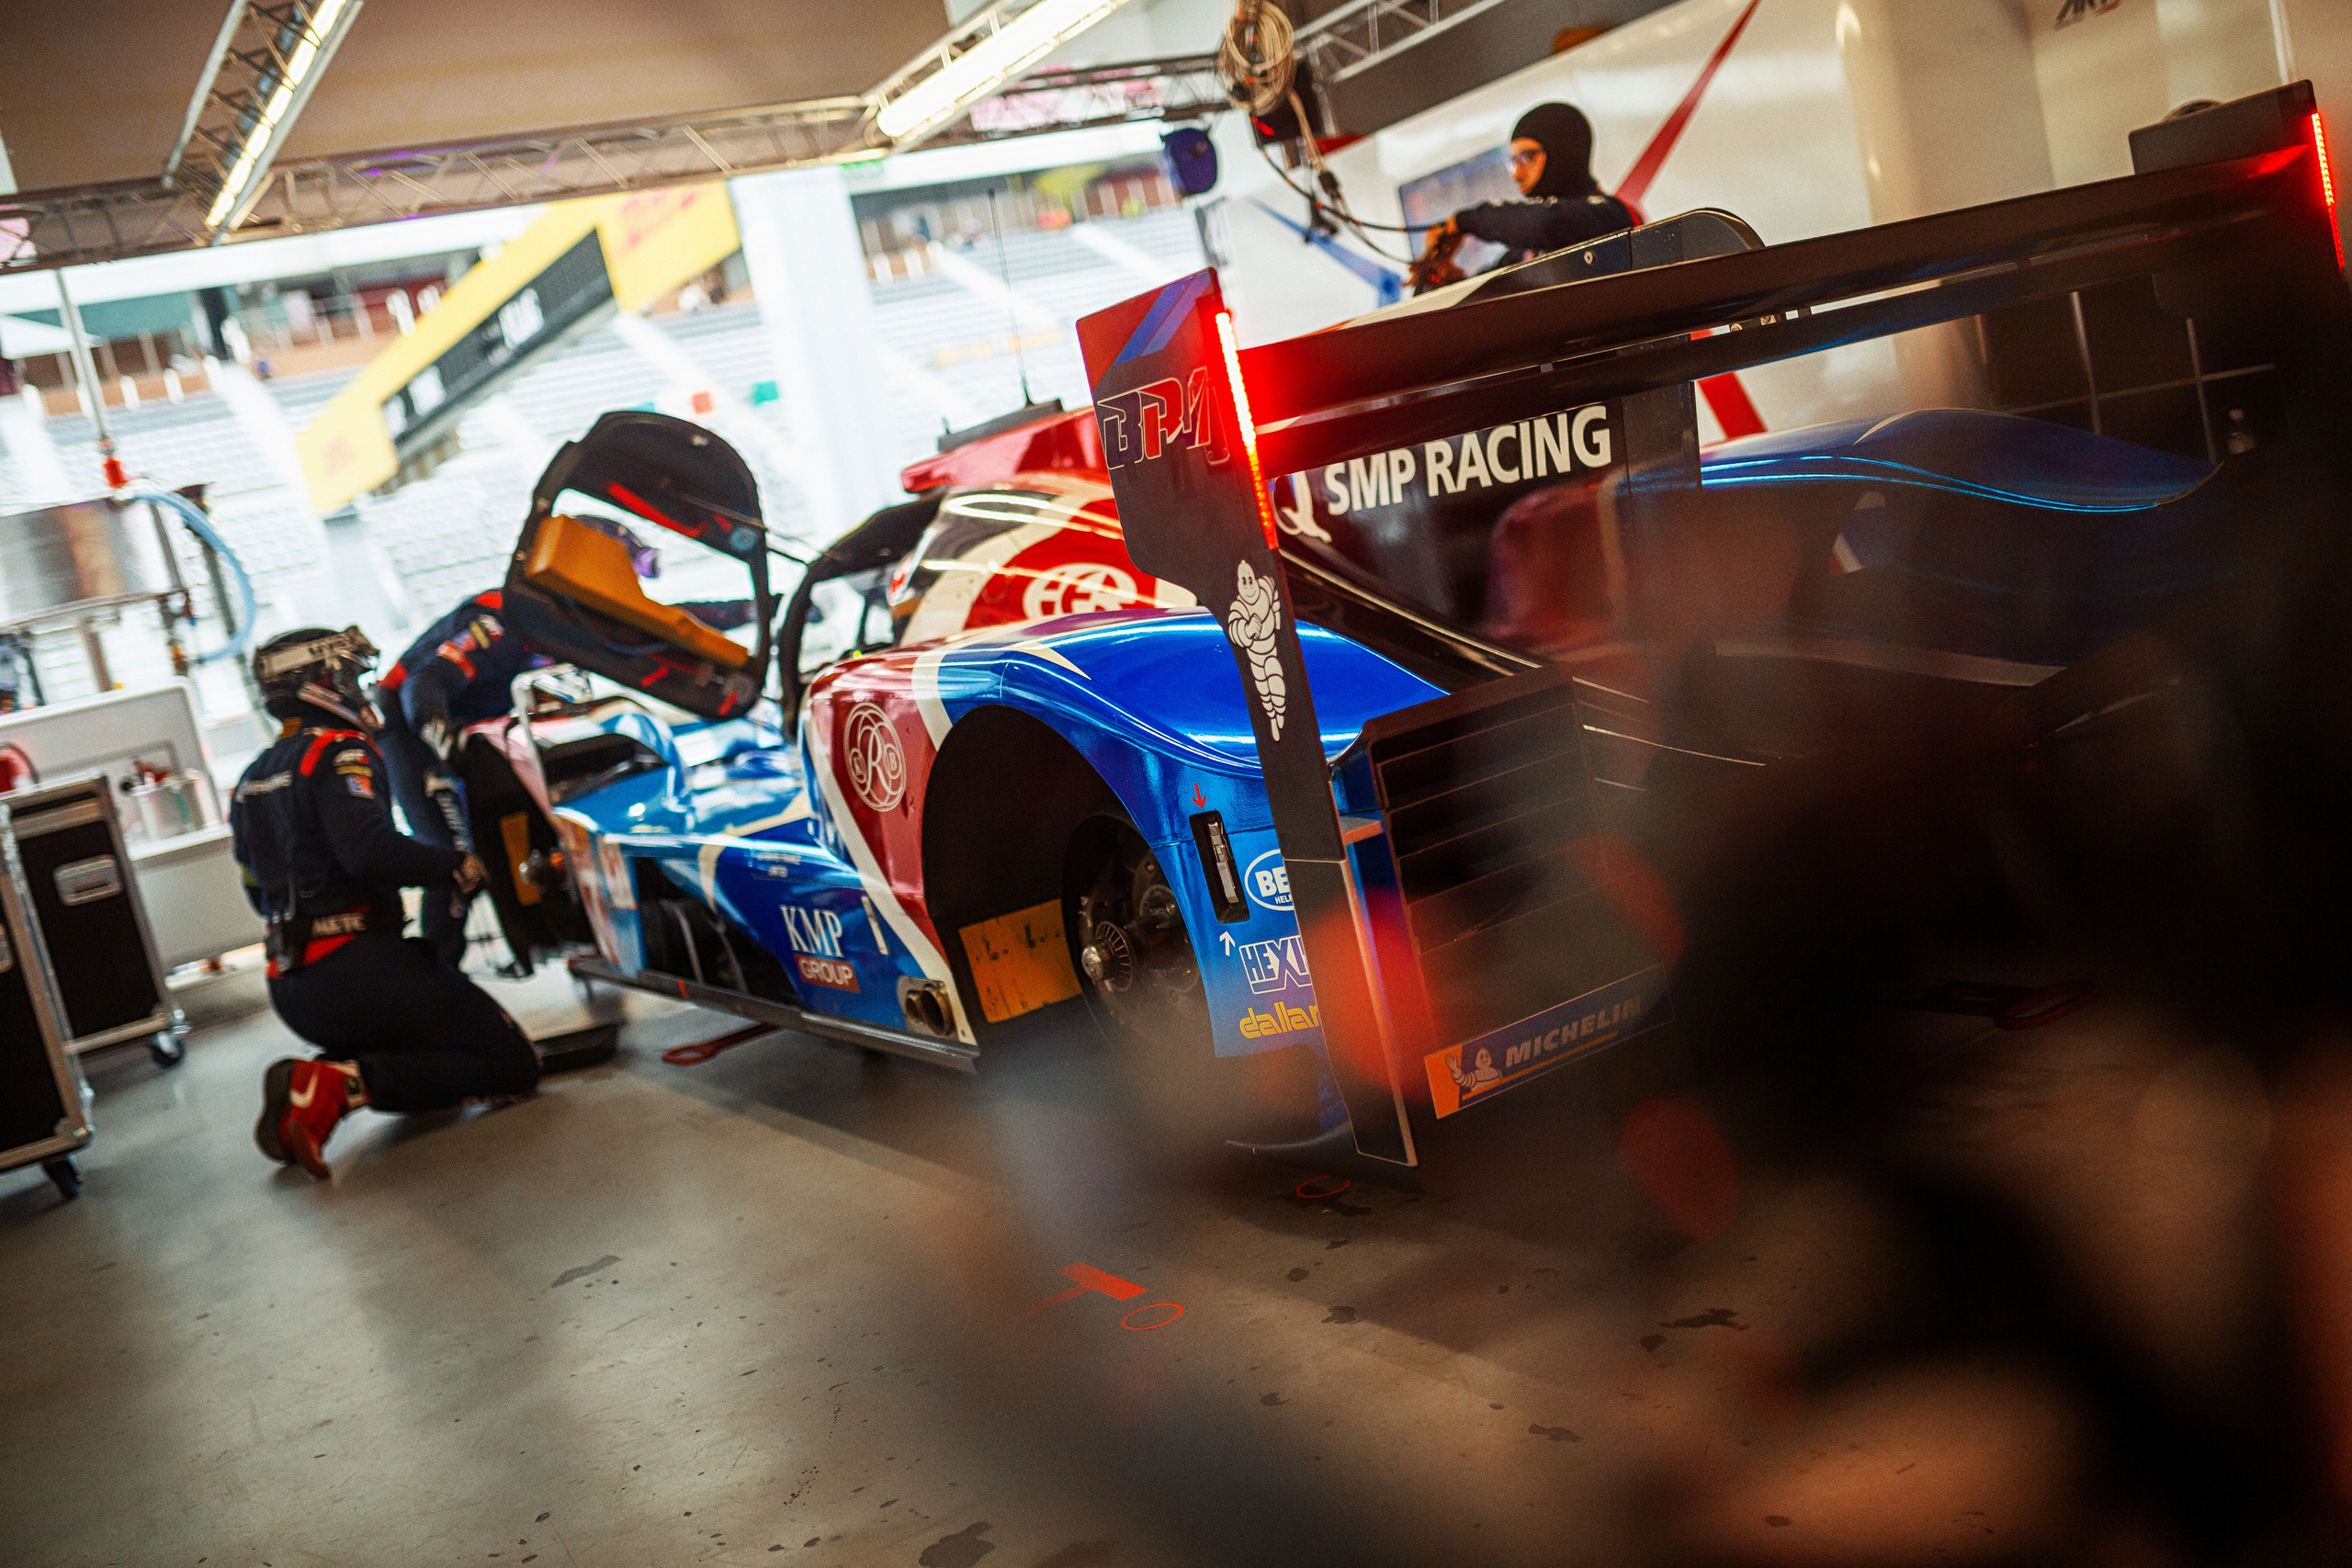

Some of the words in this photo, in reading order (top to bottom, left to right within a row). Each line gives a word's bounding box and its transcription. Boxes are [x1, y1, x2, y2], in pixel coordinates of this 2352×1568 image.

[1323, 446, 1417, 516] SMP
[1423, 404, 1612, 497] RACING
[1254, 865, 1292, 897] BE
[779, 904, 845, 958] KMP
[798, 958, 854, 987] GROUP
[1239, 1000, 1321, 1040] dallar
[1504, 994, 1644, 1069] MICHELIN
